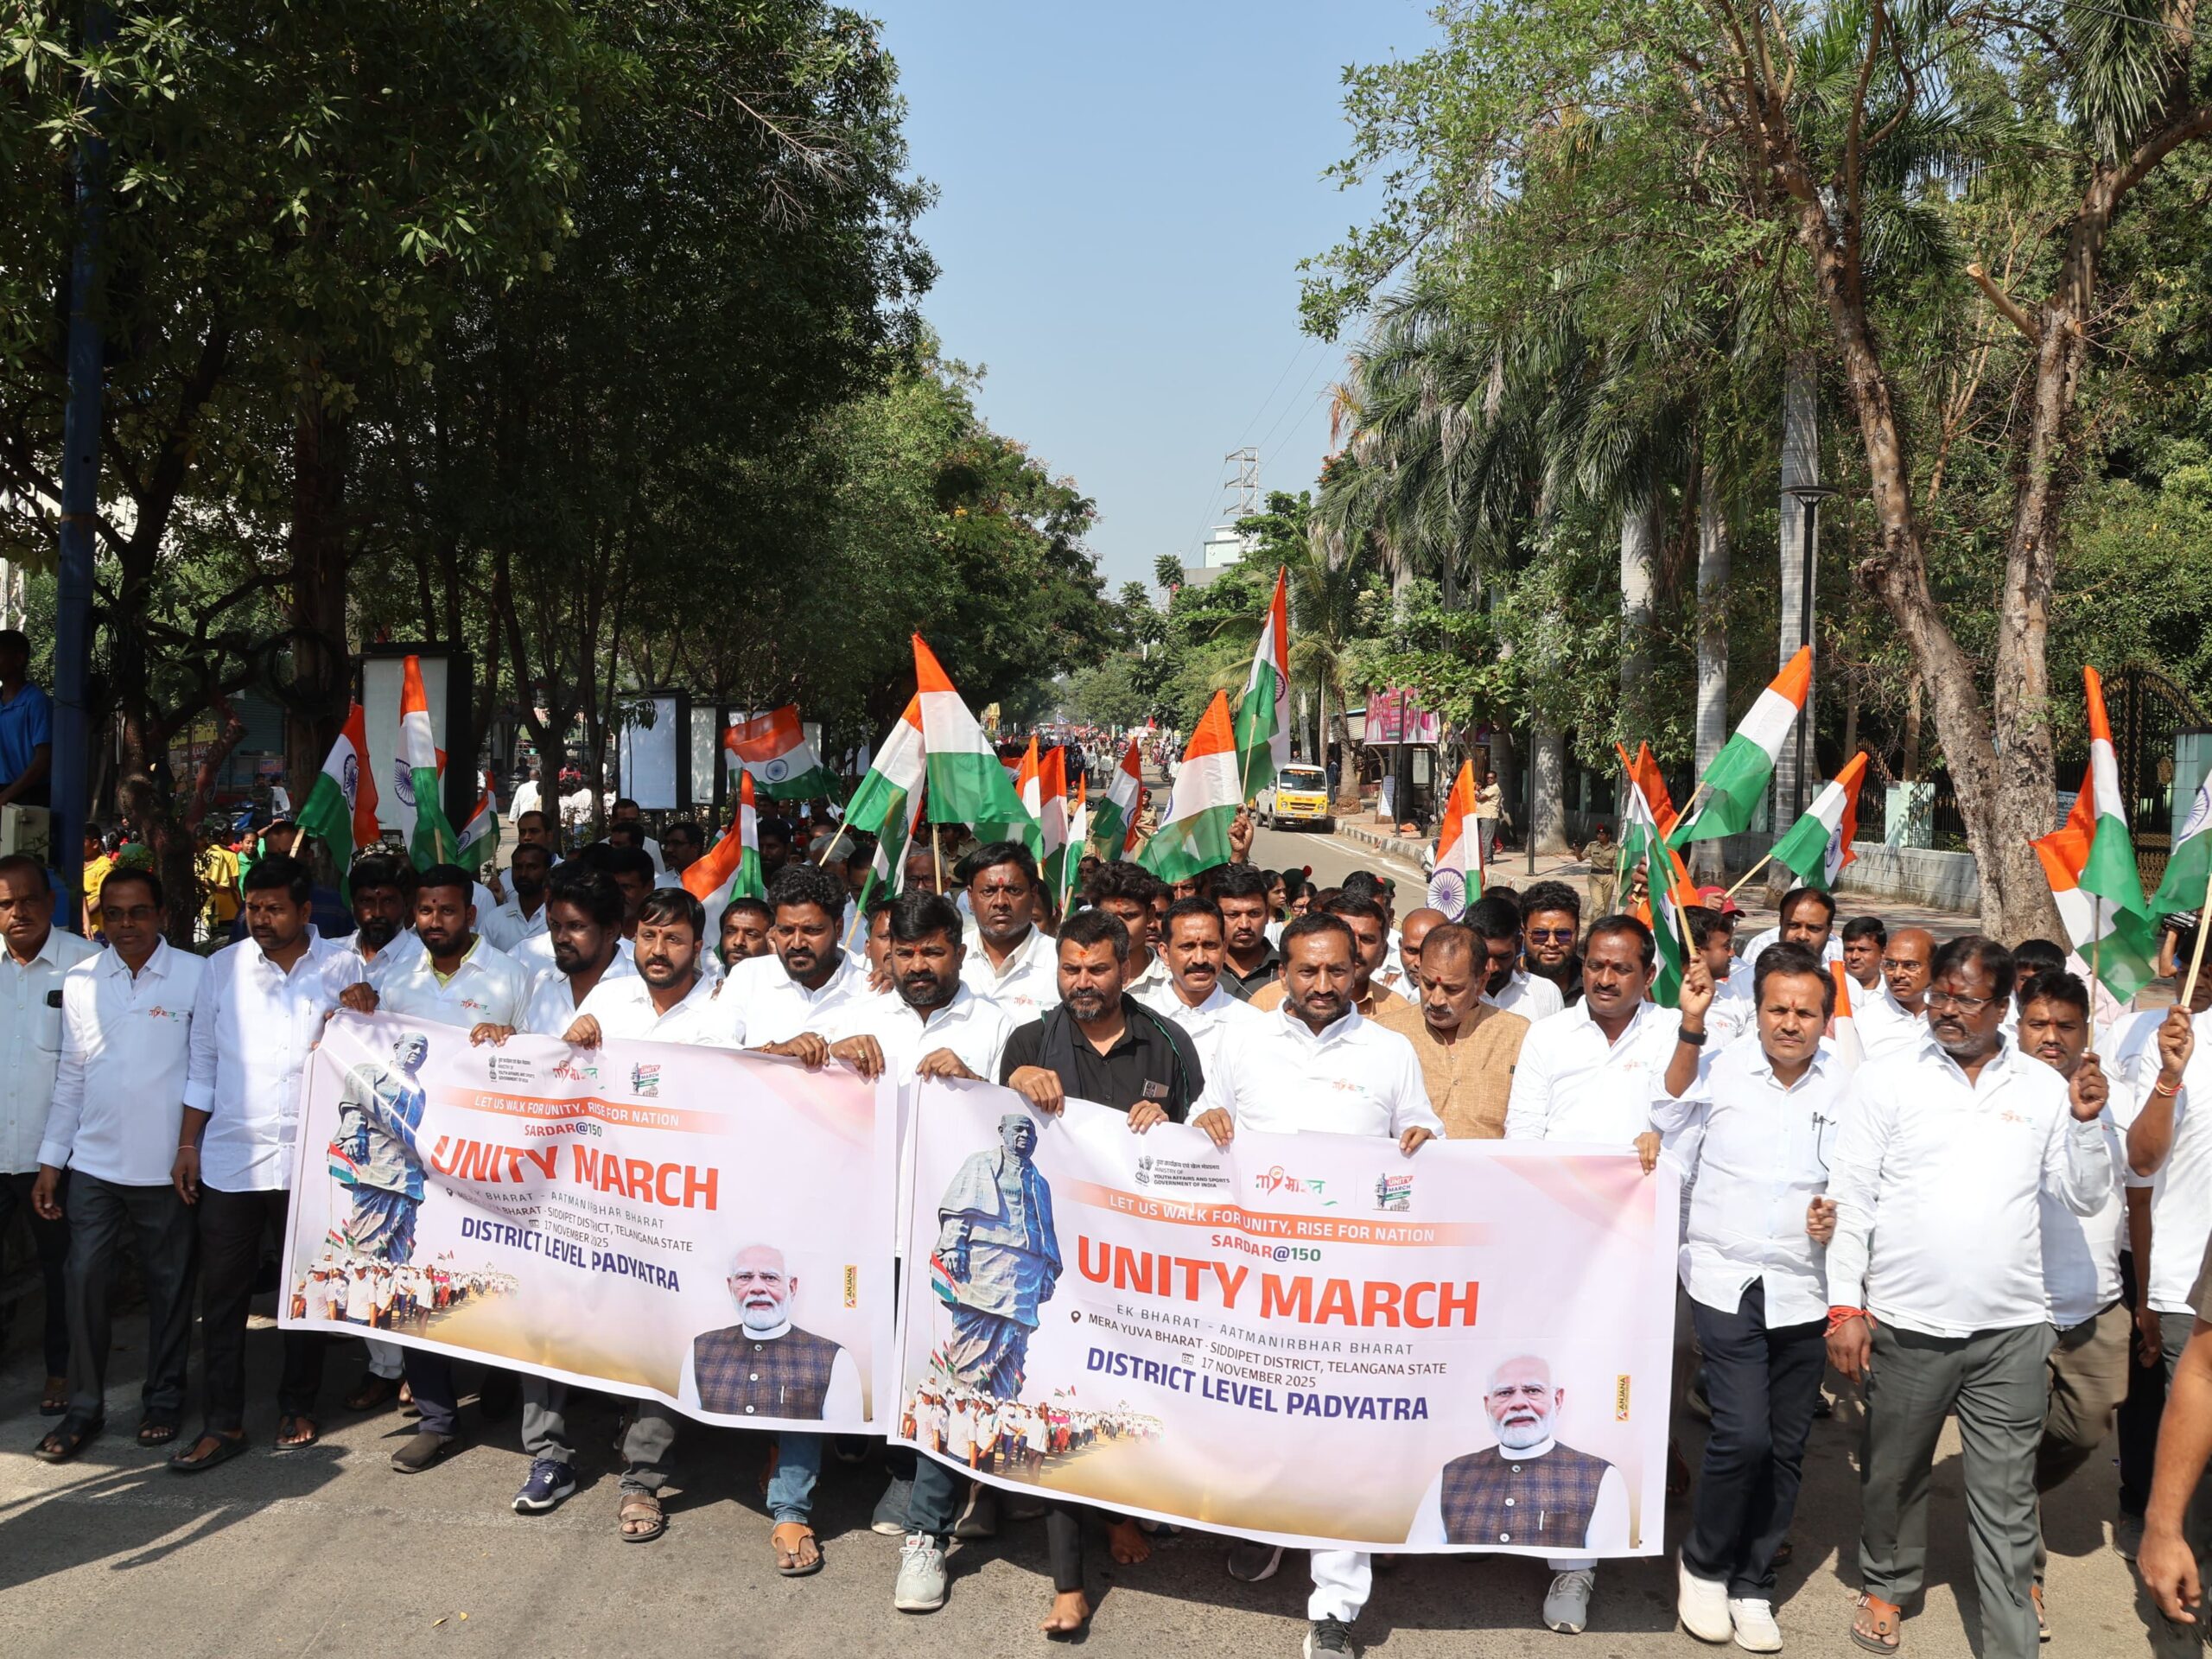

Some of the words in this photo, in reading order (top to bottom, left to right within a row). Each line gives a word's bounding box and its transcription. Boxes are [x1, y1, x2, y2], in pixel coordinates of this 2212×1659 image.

[474, 1096, 493, 1108] LET
[493, 1098, 505, 1110] US
[527, 1102, 544, 1115] FOR
[544, 1103, 585, 1116] UNITY,
[588, 1102, 605, 1116] RISE
[607, 1108, 628, 1121] FOR
[632, 1110, 679, 1126] NATION
[524, 1122, 602, 1137] SARDAR@150
[430, 1135, 558, 1183] UNITY
[572, 1144, 719, 1211] MARCH
[486, 1192, 532, 1202] BHARAT
[626, 1211, 664, 1230] BHARAT
[544, 1220, 553, 1230] 17
[553, 1223, 589, 1244] NOVEMBER
[548, 1206, 577, 1224] SIDDIPET
[615, 1224, 659, 1246] TELANGANA
[661, 1237, 694, 1252] STATE
[1109, 1195, 1135, 1211] LET
[1139, 1201, 1158, 1217] US
[1163, 1204, 1207, 1222] WALK
[1212, 1210, 1242, 1225] FOR
[1243, 1215, 1292, 1236] UNITY,
[1297, 1221, 1333, 1236] RISE
[1338, 1224, 1370, 1239] FOR
[1376, 1227, 1434, 1242] NATION
[461, 1217, 543, 1253] DISTRICT
[544, 1236, 587, 1268] LEVEL
[592, 1250, 680, 1292] PADYATRA
[1211, 1234, 1321, 1262] SARDAR@150
[1077, 1234, 1249, 1310] UNITY
[1259, 1272, 1479, 1329] MARCH
[1089, 1313, 1118, 1331] MERA
[1121, 1323, 1153, 1339] YUVA
[1155, 1331, 1203, 1349] BHARAT
[1210, 1342, 1261, 1364] SIDDIPET
[1263, 1355, 1324, 1374] DISTRICT,
[1327, 1361, 1405, 1375] TELANGANA
[1408, 1363, 1447, 1375] STATE
[1117, 1304, 1134, 1317] EK
[1141, 1309, 1200, 1329] BHARAT
[1219, 1324, 1341, 1352] AATMANIRBHAR
[1350, 1344, 1414, 1355] BHARAT
[1087, 1347, 1196, 1394] DISTRICT
[1202, 1375, 1278, 1413] LEVEL
[1287, 1392, 1428, 1421] PADYATRA
[1202, 1357, 1214, 1370] 17
[1216, 1361, 1282, 1385] NOVEMBER
[1285, 1375, 1316, 1388] 2025
